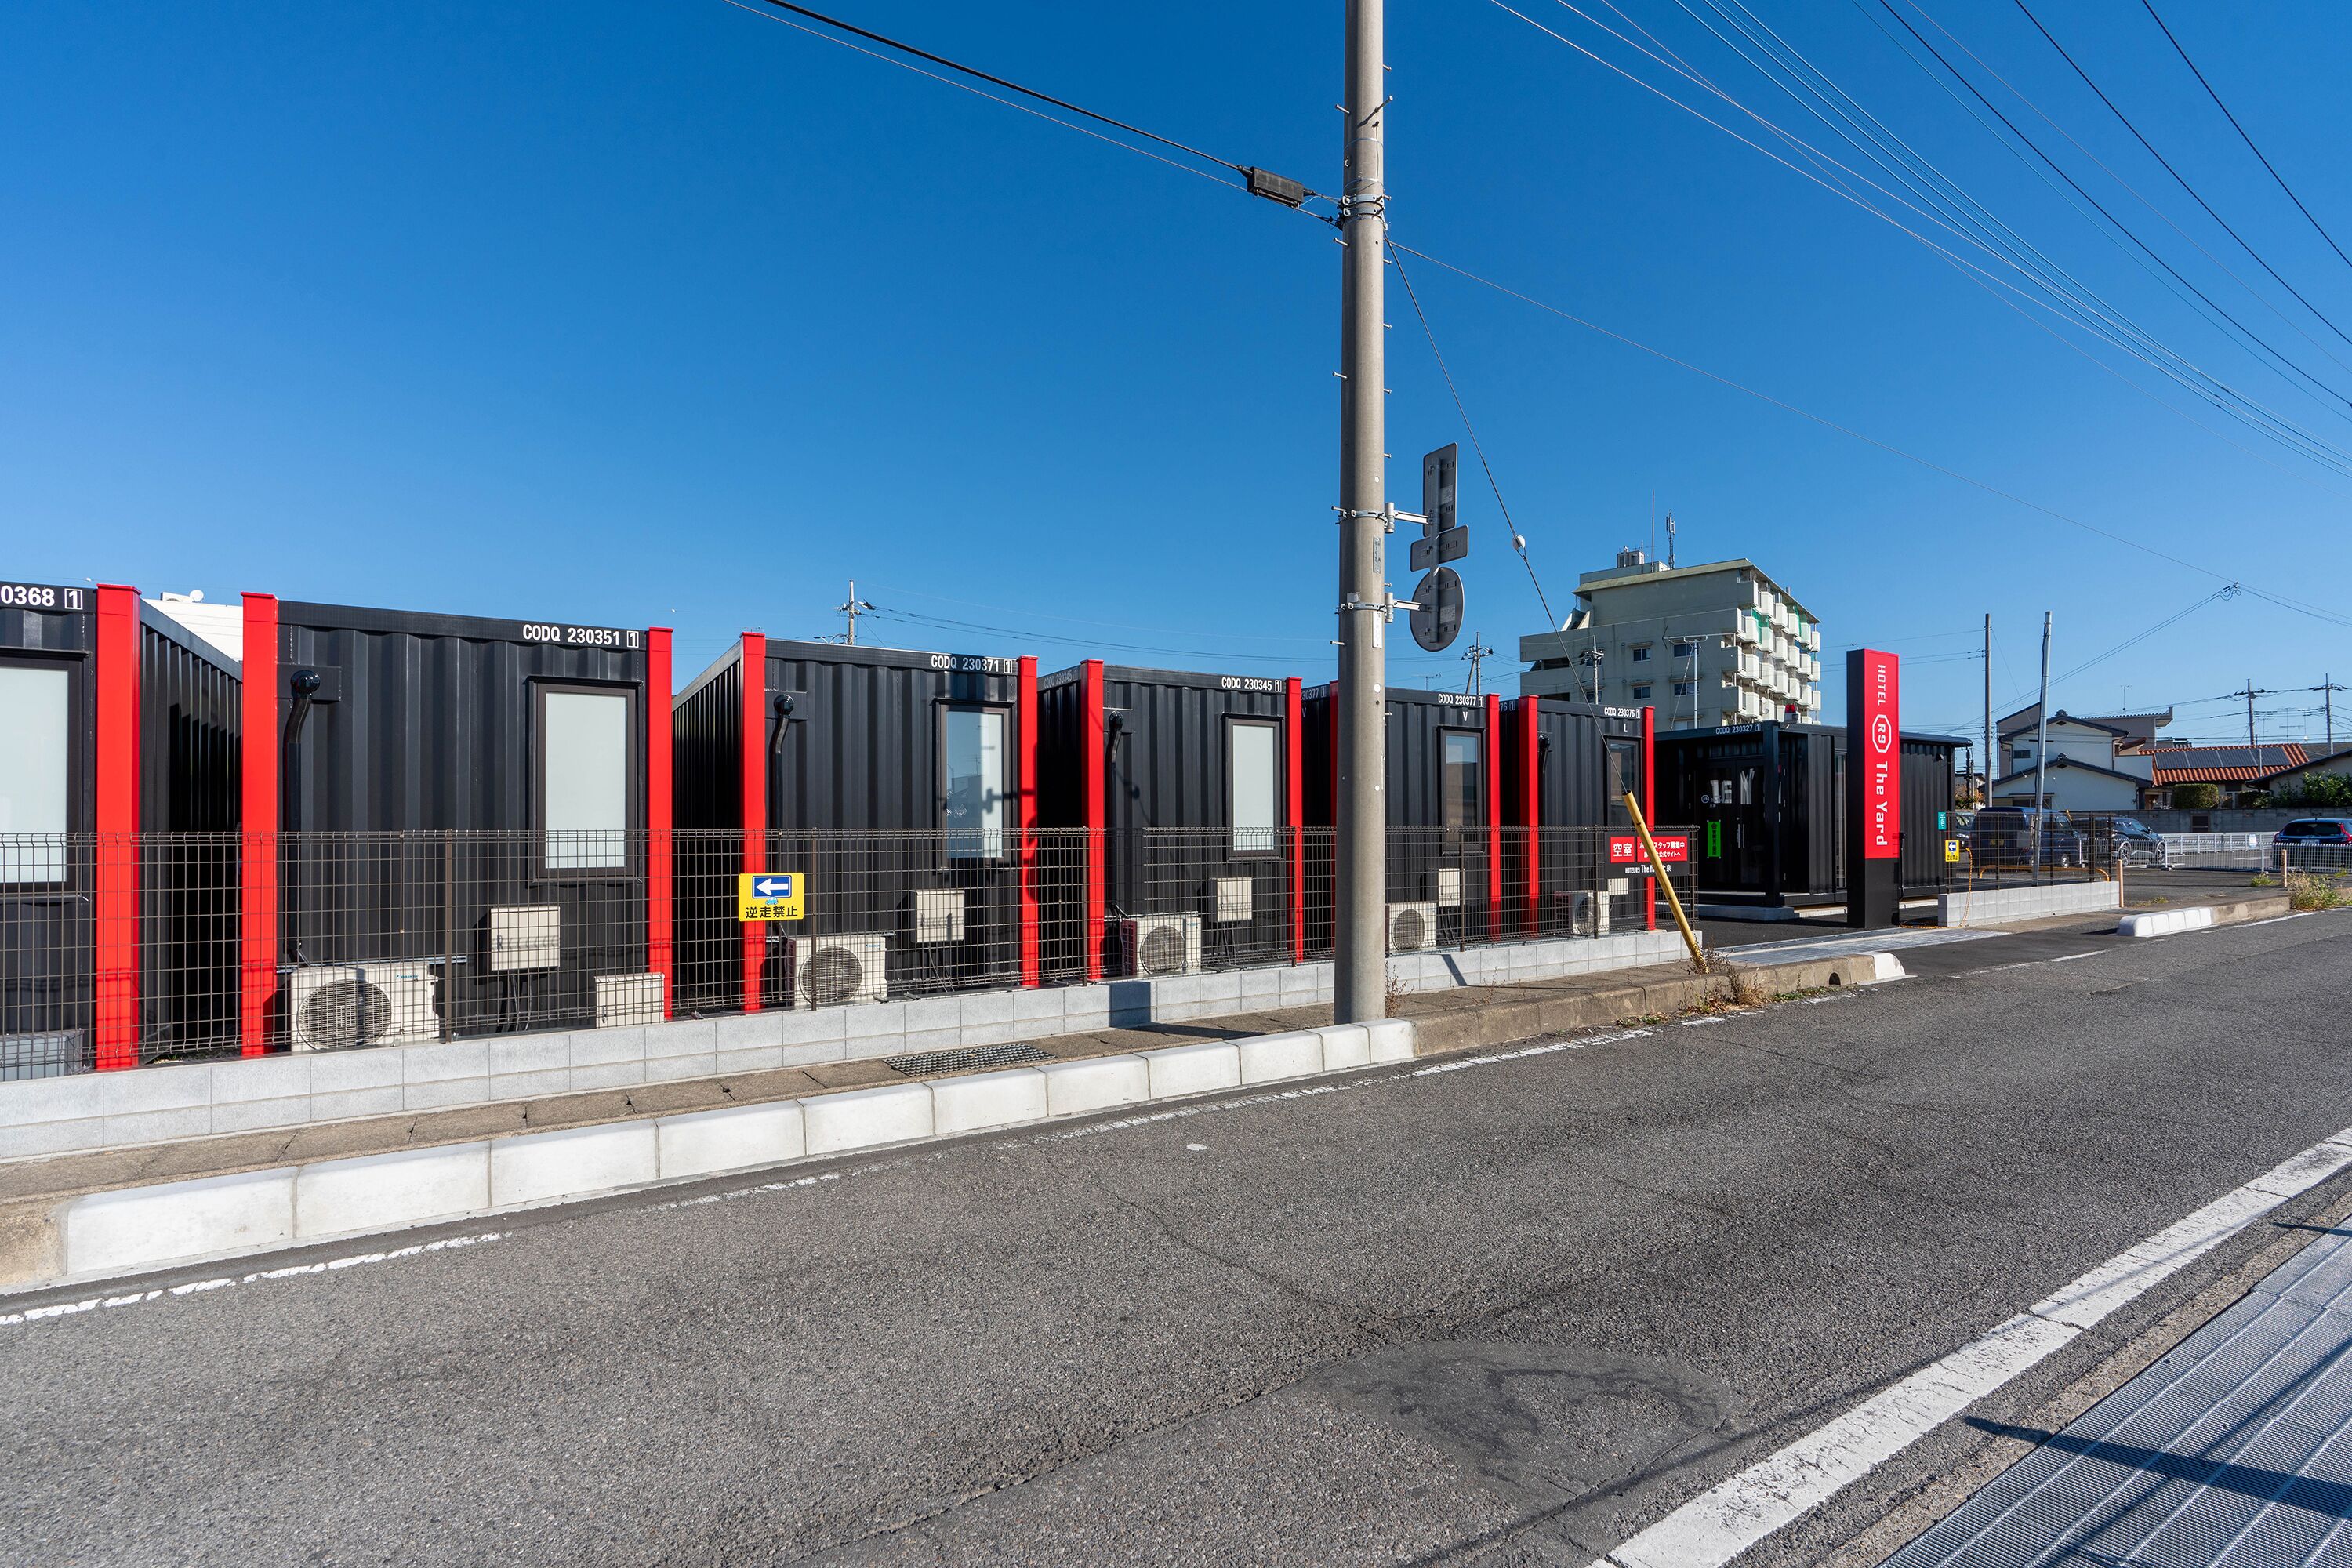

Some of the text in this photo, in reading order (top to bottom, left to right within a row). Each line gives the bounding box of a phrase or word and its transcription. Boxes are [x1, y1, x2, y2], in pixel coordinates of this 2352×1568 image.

[523, 624, 561, 642] CODQ
[568, 627, 619, 646] 230351
[931, 655, 957, 670] CODQ
[962, 657, 999, 672] 230371
[1221, 677, 1241, 689] CODQ
[1244, 678, 1272, 691] 230345
[1438, 693, 1454, 704] CODQ
[1455, 695, 1476, 706] 230377
[1499, 702, 1508, 712] 76
[1617, 708, 1635, 717] 230376
[1462, 711, 1468, 721] V
[1624, 723, 1628, 732] L
[1732, 724, 1753, 733] 230327
[1876, 664, 1888, 846] HOTEL R9 The Yard
[1613, 843, 1632, 857] 空室
[1639, 841, 1685, 850] ホスタッフ募集中
[1641, 864, 1650, 873] The
[746, 905, 798, 919] 逆走禁止
